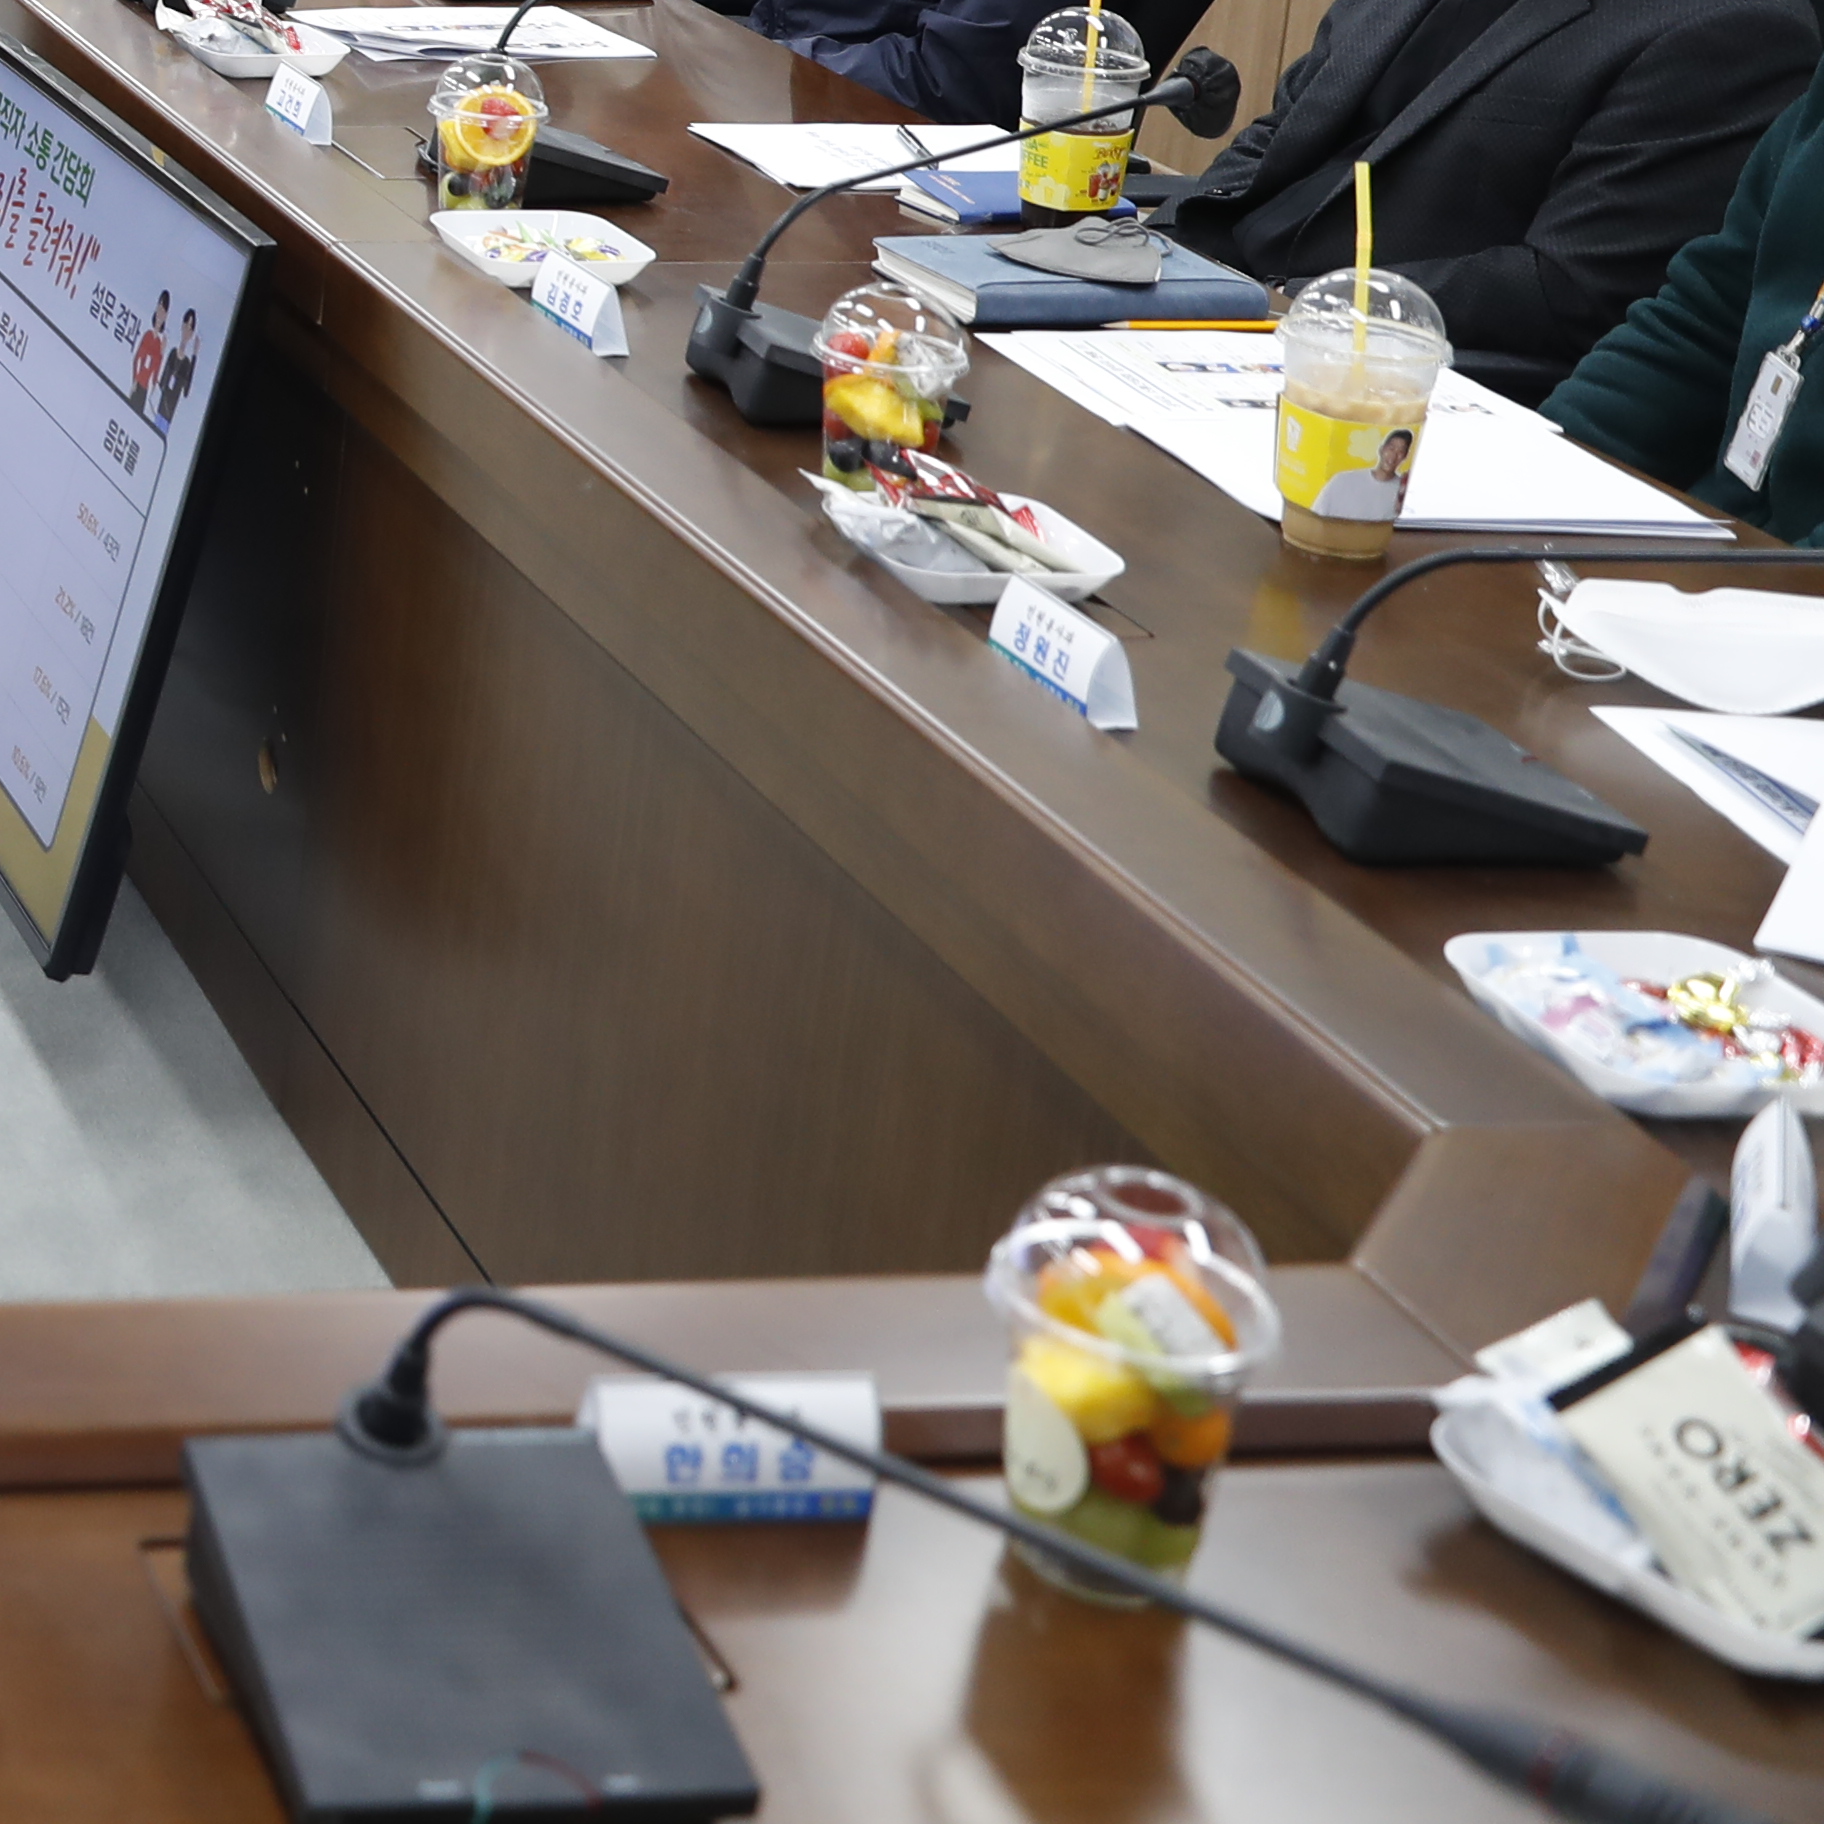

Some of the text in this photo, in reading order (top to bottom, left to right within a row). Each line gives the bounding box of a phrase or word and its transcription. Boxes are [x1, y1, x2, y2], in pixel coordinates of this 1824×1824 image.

[23, 121, 54, 172] 소통
[51, 140, 97, 209] 간담회
[89, 281, 143, 354] 설문 결과
[103, 419, 140, 475] 응답률
[1673, 1416, 1814, 1556] ZERO
